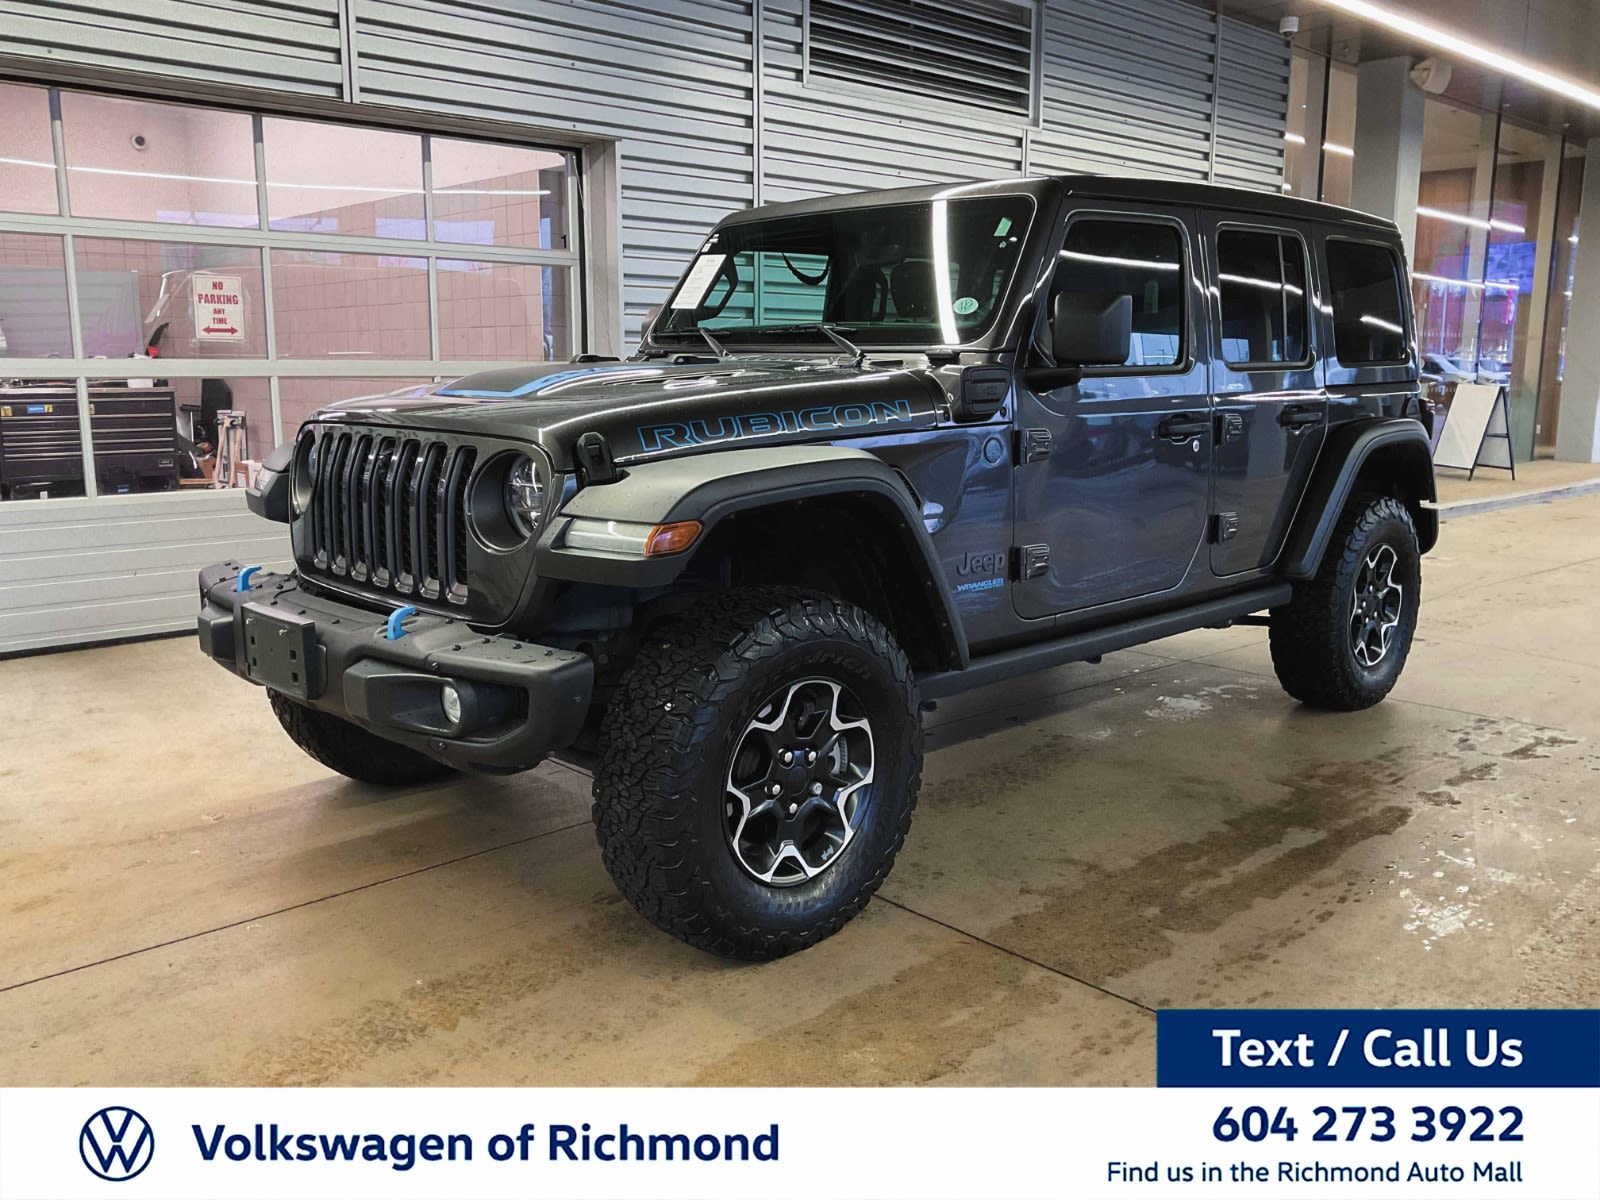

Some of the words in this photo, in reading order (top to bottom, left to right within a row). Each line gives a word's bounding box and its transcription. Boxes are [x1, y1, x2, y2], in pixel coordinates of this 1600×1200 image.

[212, 281, 224, 290] NO
[198, 294, 239, 305] PARKING
[213, 317, 228, 325] TIME
[637, 400, 912, 451] RUBICON
[956, 551, 1006, 576] Jeep
[956, 577, 1004, 592] WRANGLER
